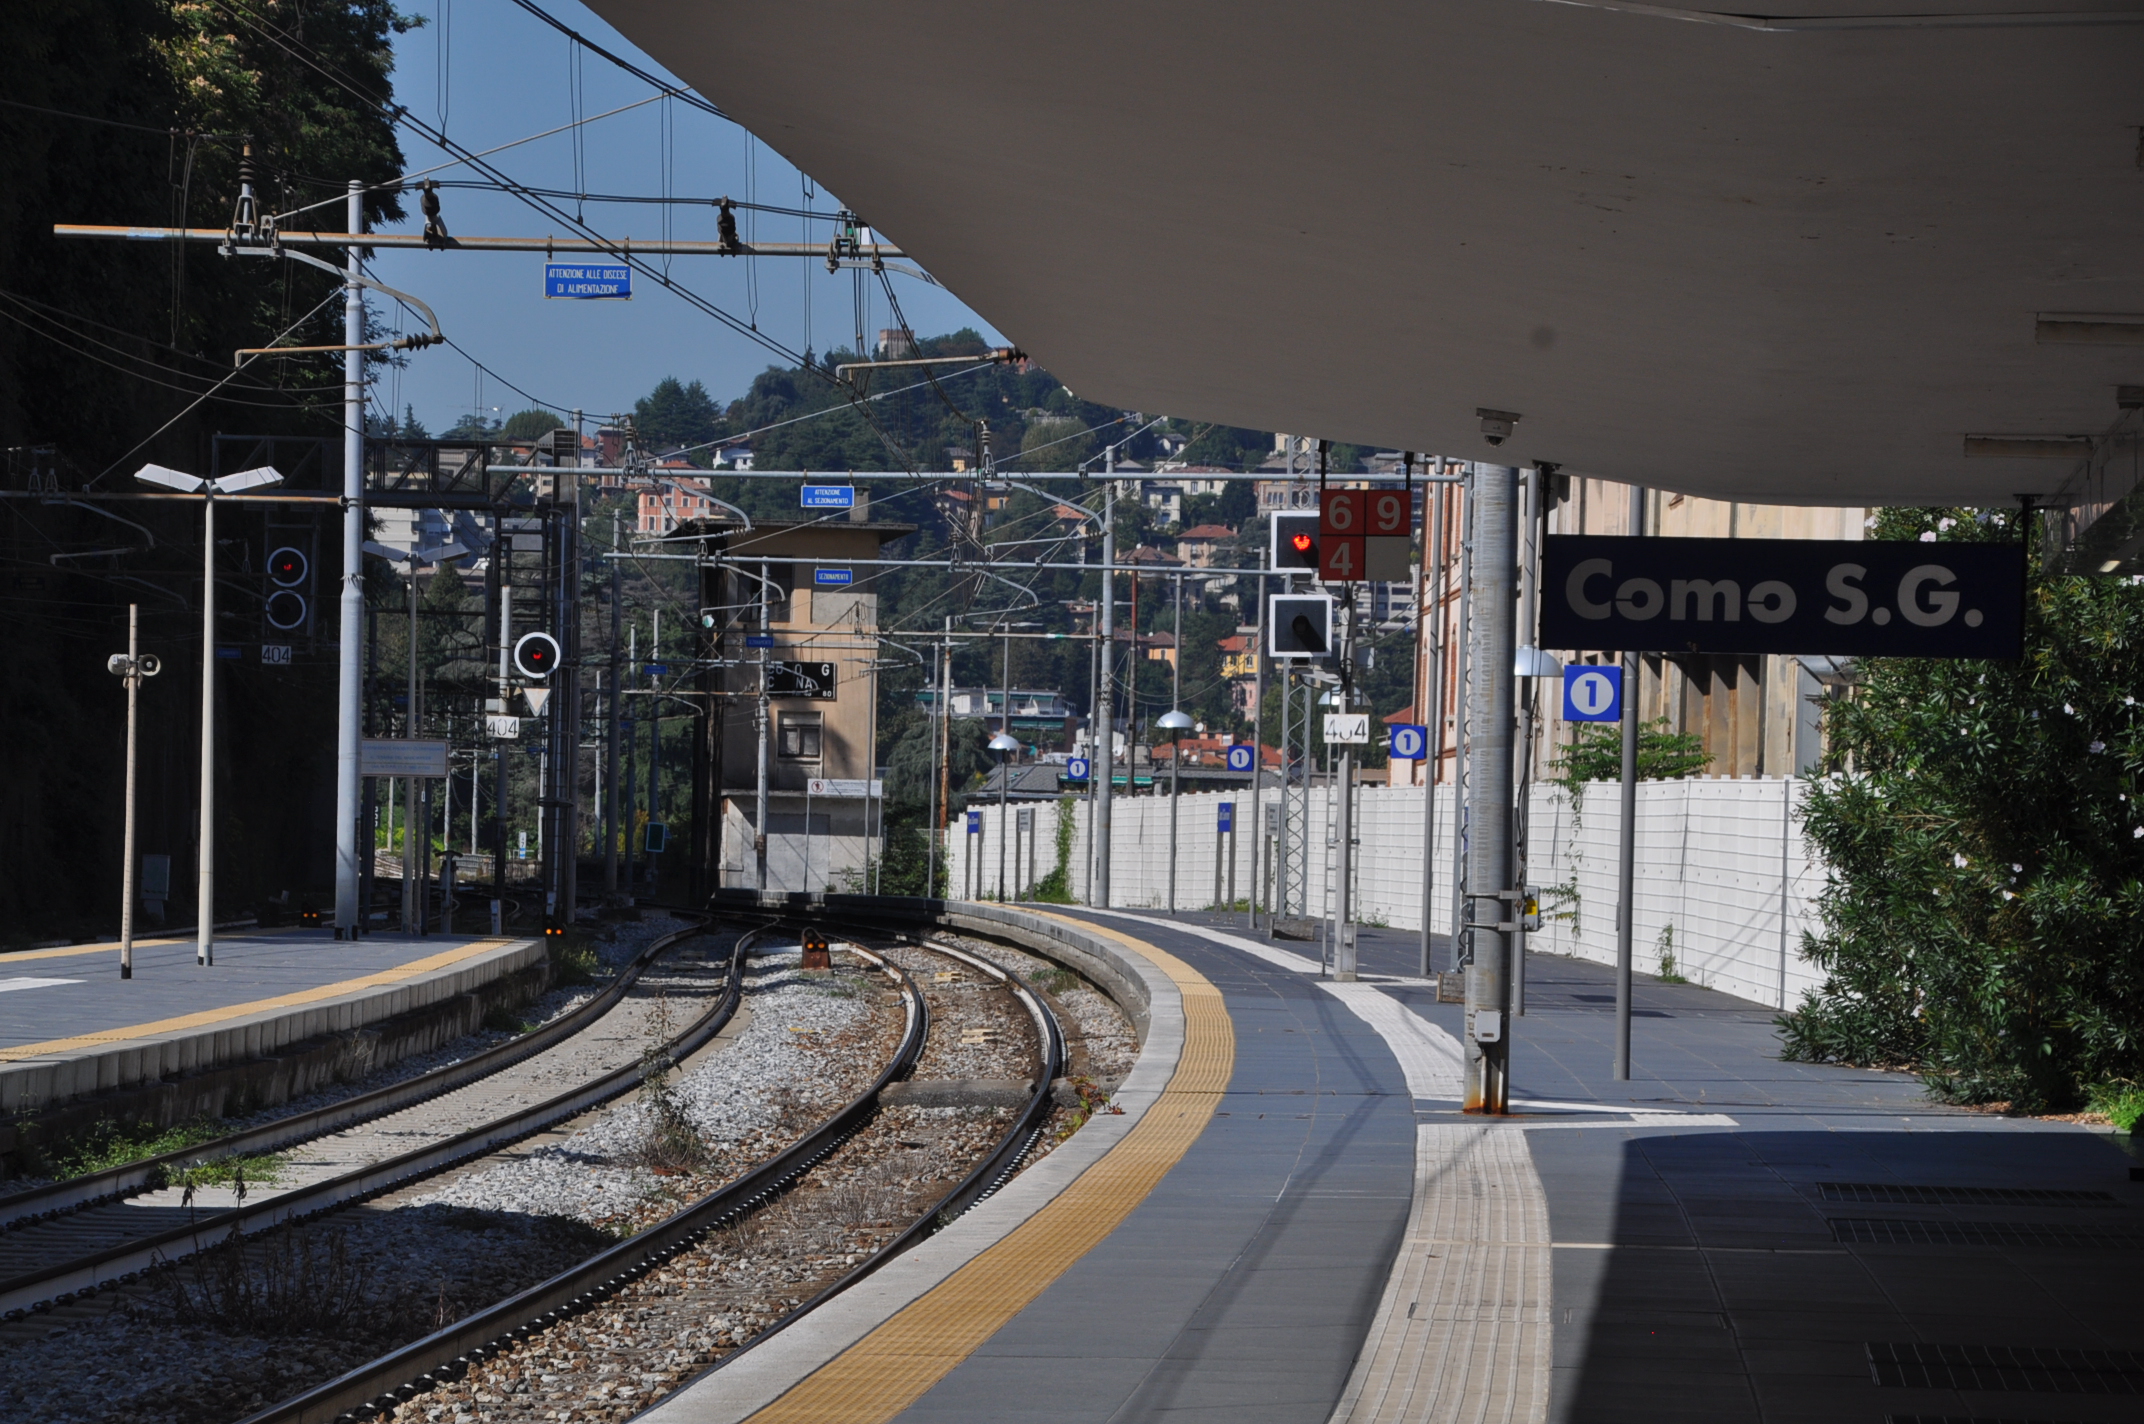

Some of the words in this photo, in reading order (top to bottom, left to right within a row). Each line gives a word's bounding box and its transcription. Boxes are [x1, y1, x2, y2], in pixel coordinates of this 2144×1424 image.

[548, 268, 584, 278] ATTENZIONE
[586, 269, 601, 279] ALLE
[604, 270, 628, 280] DISCESE
[557, 283, 564, 293] DI
[568, 284, 619, 294] ALIMENTAZIONE
[1328, 494, 1352, 530] 6
[1376, 495, 1401, 531] 9
[1329, 542, 1353, 576] 4
[1565, 558, 1797, 622] Como
[1823, 562, 1984, 628] S.G.
[262, 646, 291, 662] 404
[1585, 680, 1597, 707] 1
[487, 718, 518, 736] 404
[1404, 734, 1411, 750] 1
[1236, 752, 1242, 764] 1
[1075, 764, 1080, 774] 1
